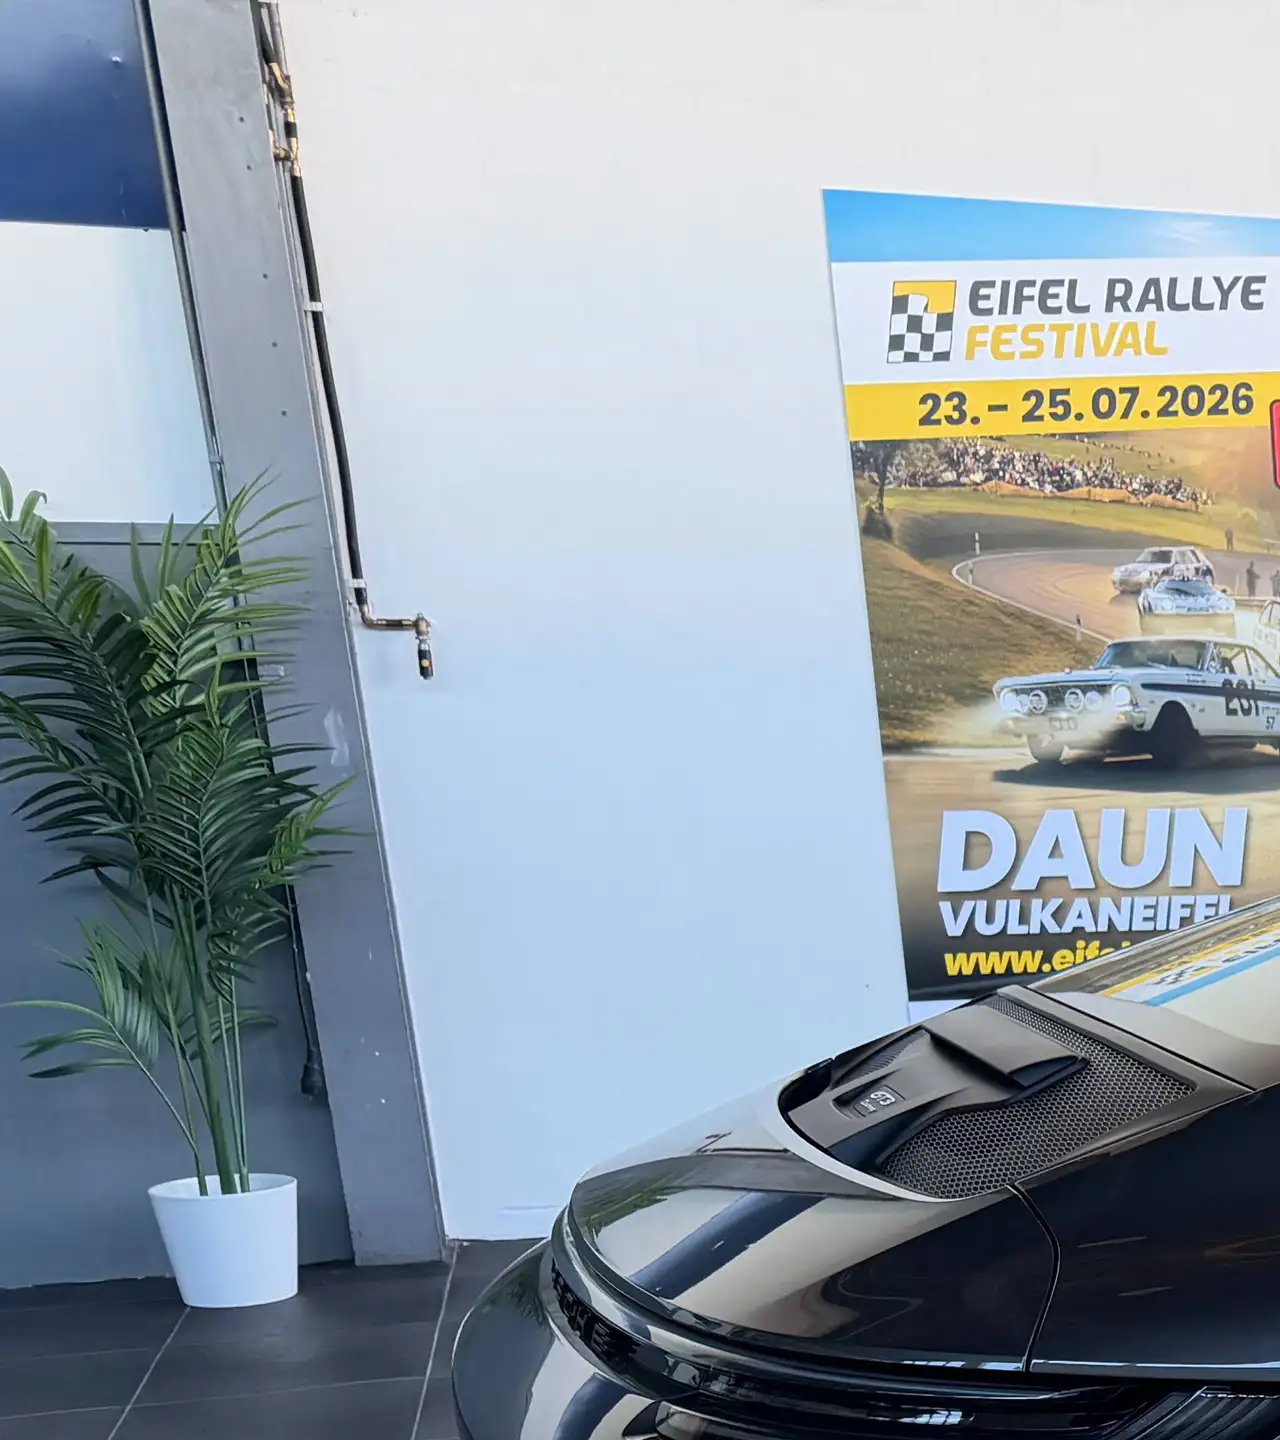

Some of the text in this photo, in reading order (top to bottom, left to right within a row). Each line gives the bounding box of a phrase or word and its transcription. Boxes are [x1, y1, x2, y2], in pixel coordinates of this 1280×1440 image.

[968, 275, 1267, 316] EIFEL RALLYE
[965, 320, 1169, 361] FESTIVAL
[1021, 382, 1255, 423] 25.07.2026
[936, 807, 1248, 893] DAUN
[870, 1090, 896, 1106] GT3
